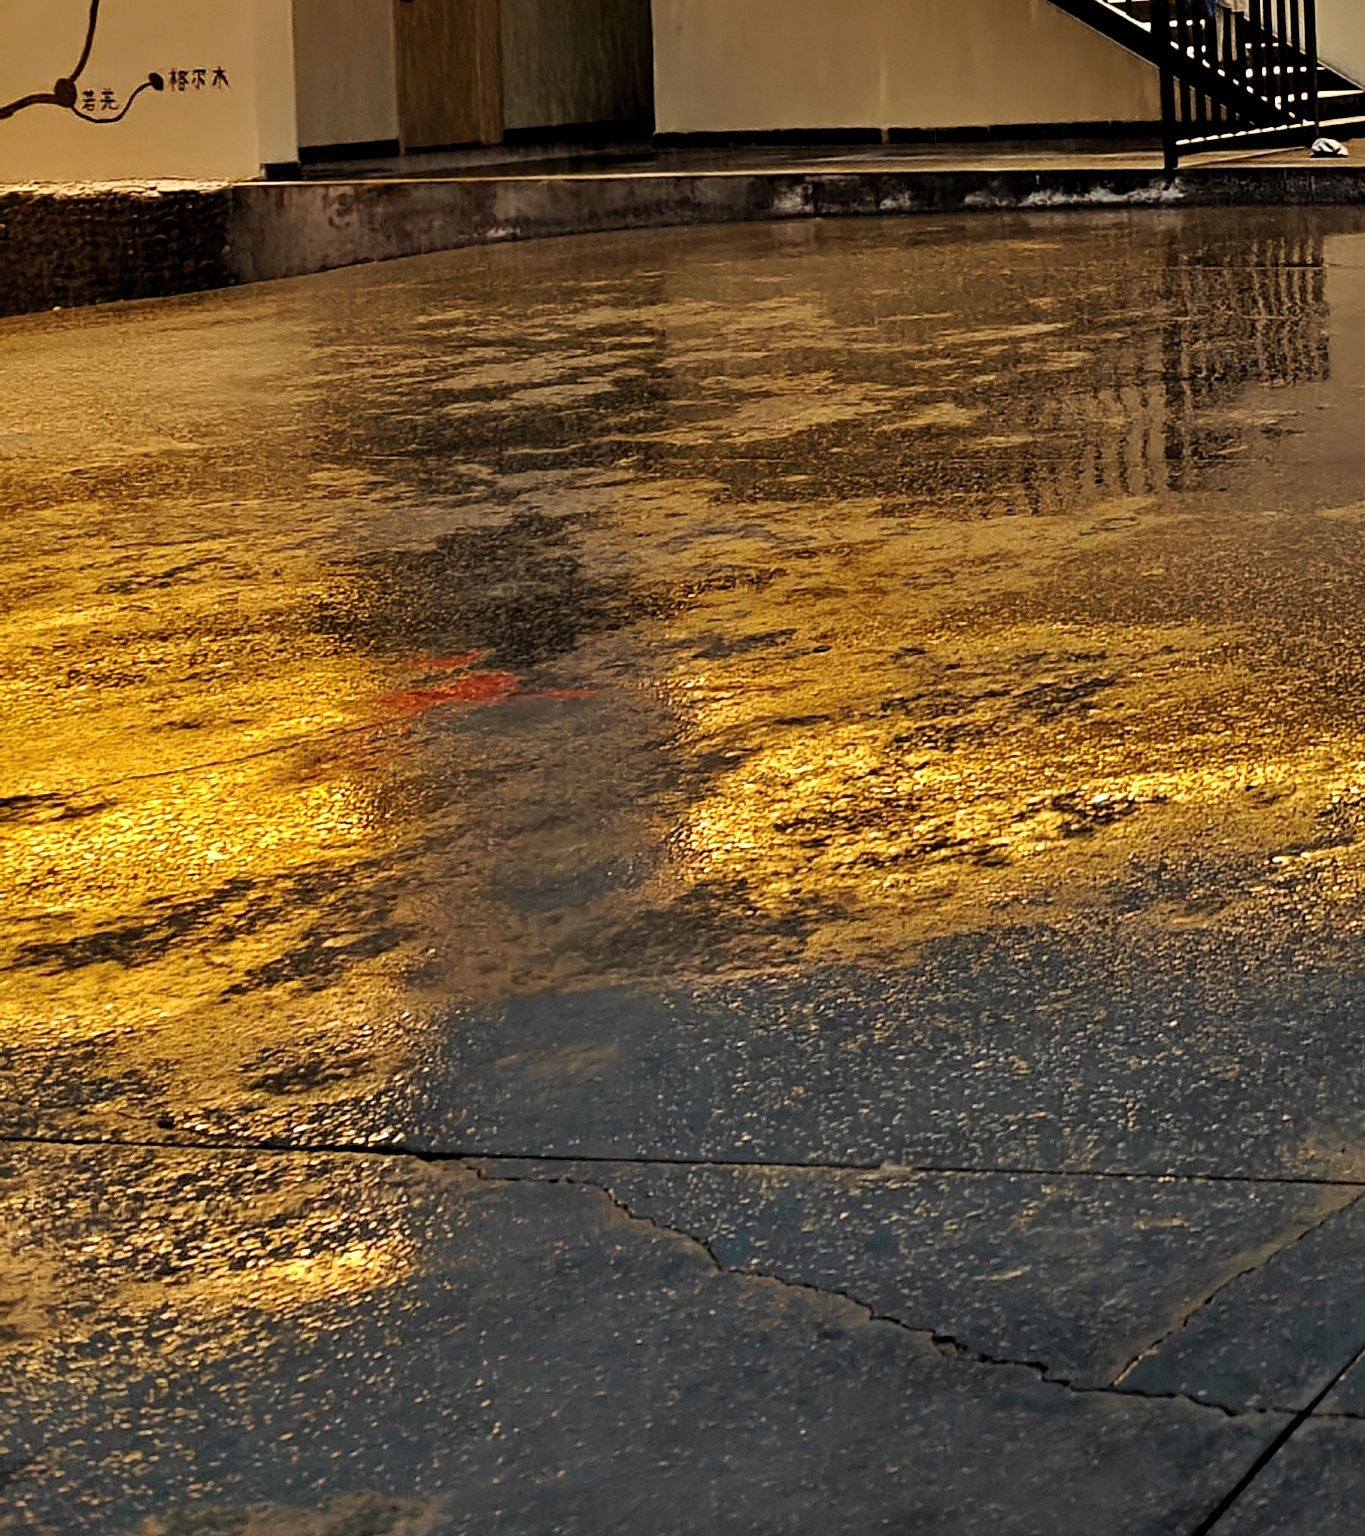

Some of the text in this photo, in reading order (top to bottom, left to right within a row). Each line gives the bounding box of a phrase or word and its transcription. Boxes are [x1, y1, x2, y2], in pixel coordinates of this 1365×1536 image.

[169, 66, 231, 92] 格尔木
[81, 87, 119, 111] 若羌
